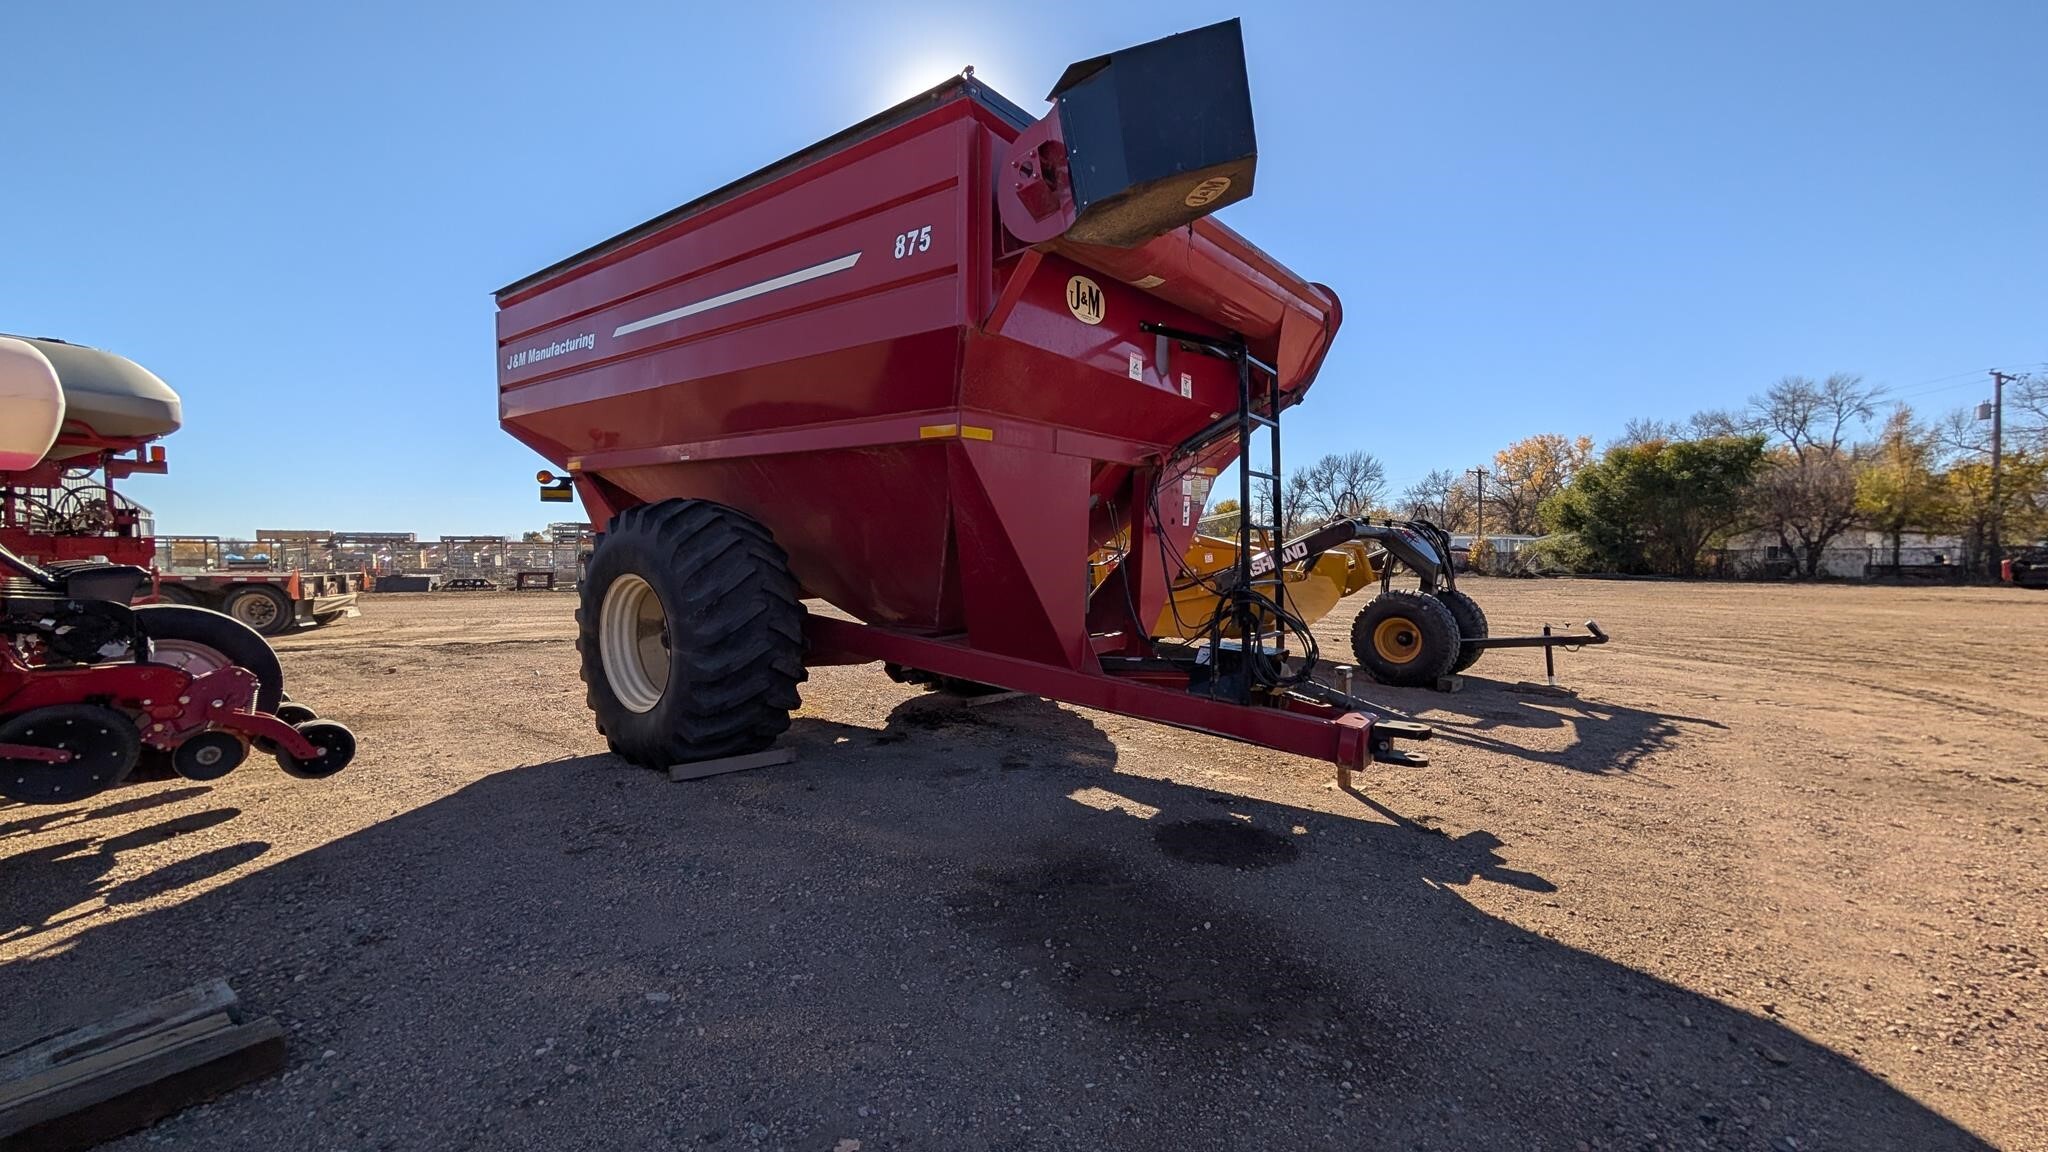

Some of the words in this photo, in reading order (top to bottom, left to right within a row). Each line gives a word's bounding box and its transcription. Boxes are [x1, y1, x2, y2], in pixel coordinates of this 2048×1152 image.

[1190, 180, 1226, 204] J&M
[894, 224, 932, 259] 875
[1069, 279, 1101, 319] J&M
[506, 351, 527, 370] J&M
[527, 333, 595, 364] Manufacturing
